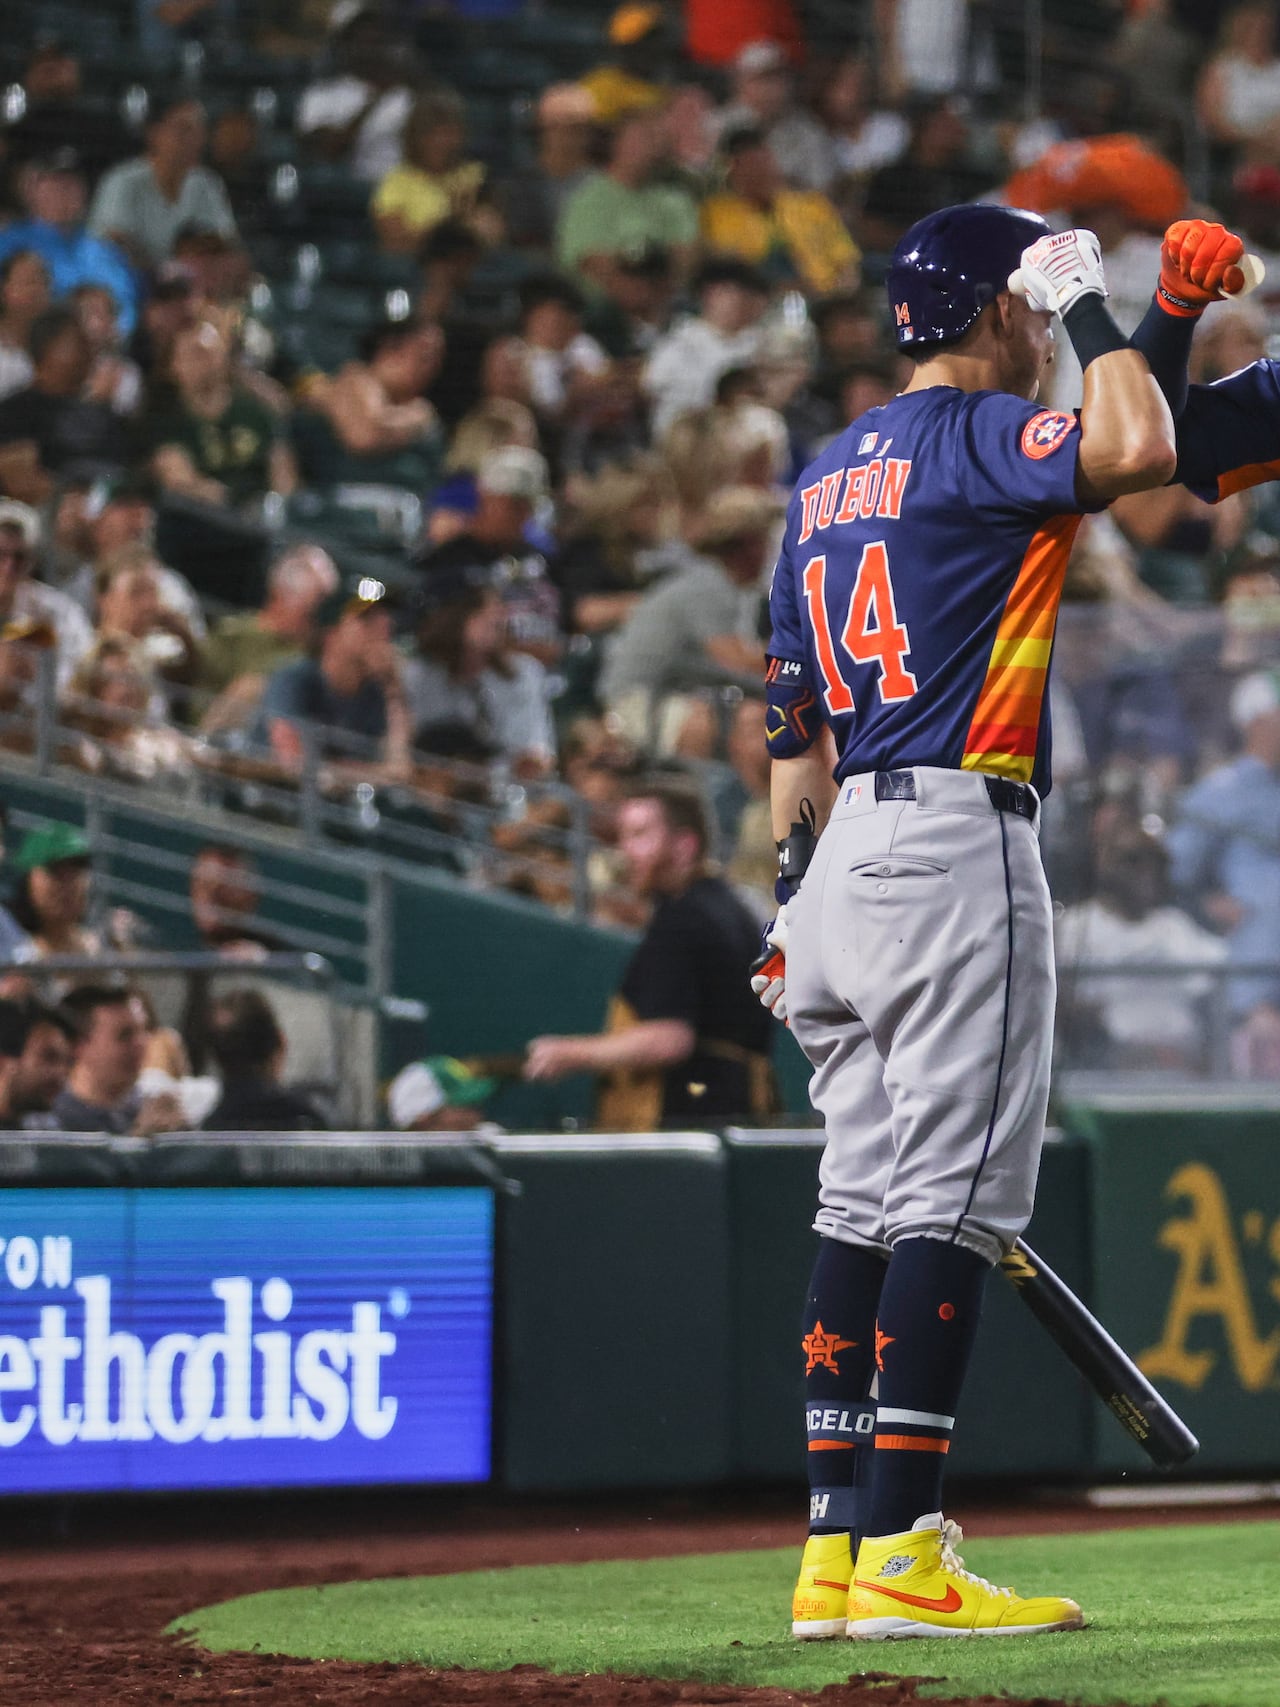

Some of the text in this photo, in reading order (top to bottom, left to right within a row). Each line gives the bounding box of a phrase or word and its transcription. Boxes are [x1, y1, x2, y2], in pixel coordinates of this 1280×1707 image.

[894, 302, 911, 326] 14
[803, 540, 919, 716] 14
[781, 660, 802, 676] 14
[0, 1235, 73, 1290] ON
